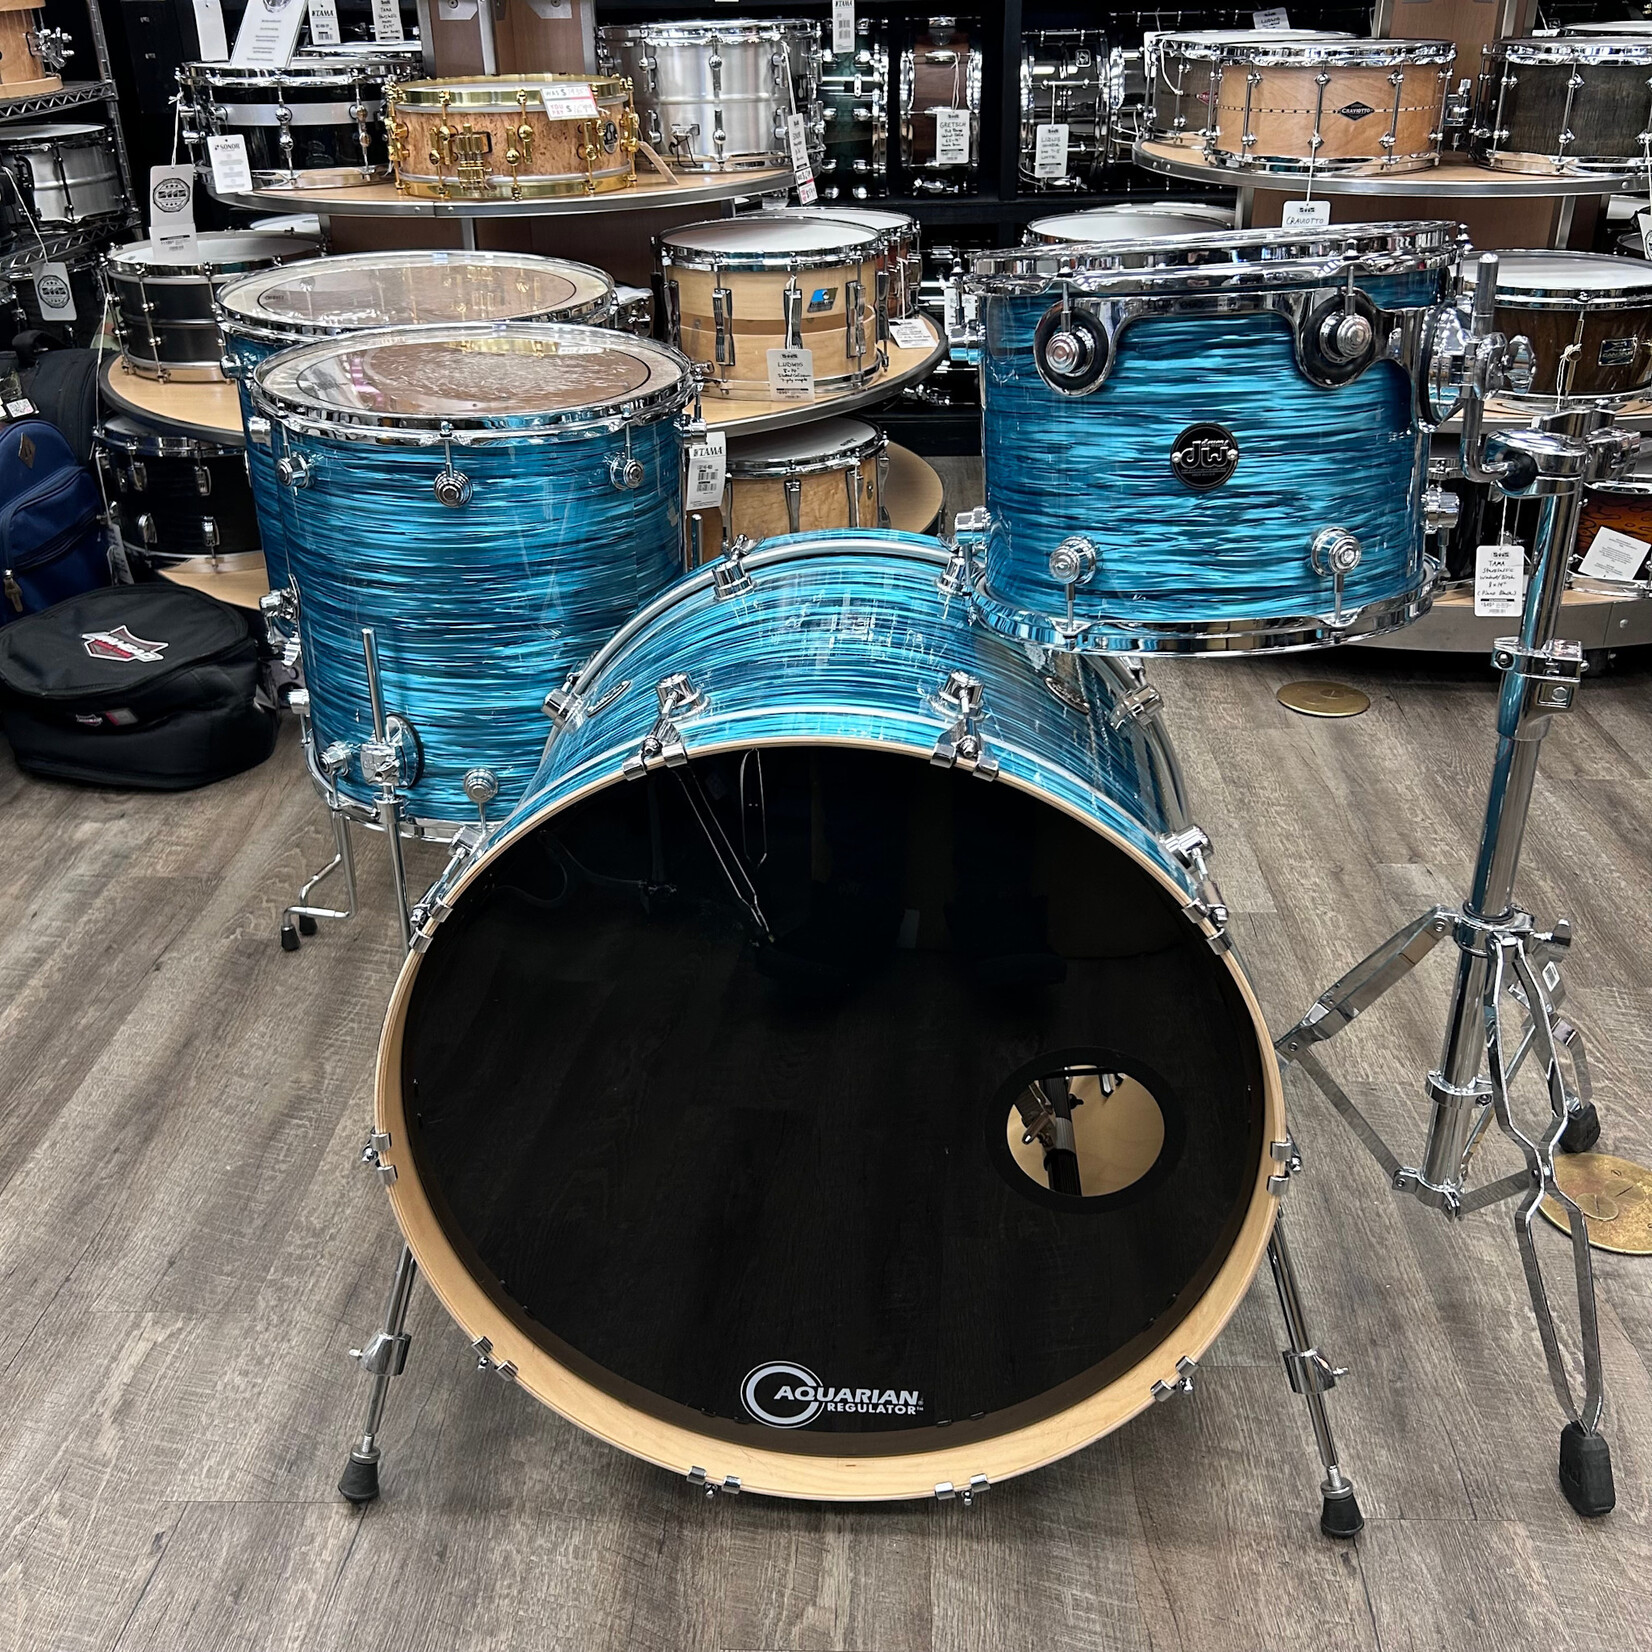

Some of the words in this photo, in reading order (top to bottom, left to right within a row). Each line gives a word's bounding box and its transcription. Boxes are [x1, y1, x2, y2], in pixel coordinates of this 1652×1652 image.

[699, 446, 723, 456] TAMA
[1180, 441, 1229, 469] dw
[773, 1385, 919, 1405] AQUARIAN
